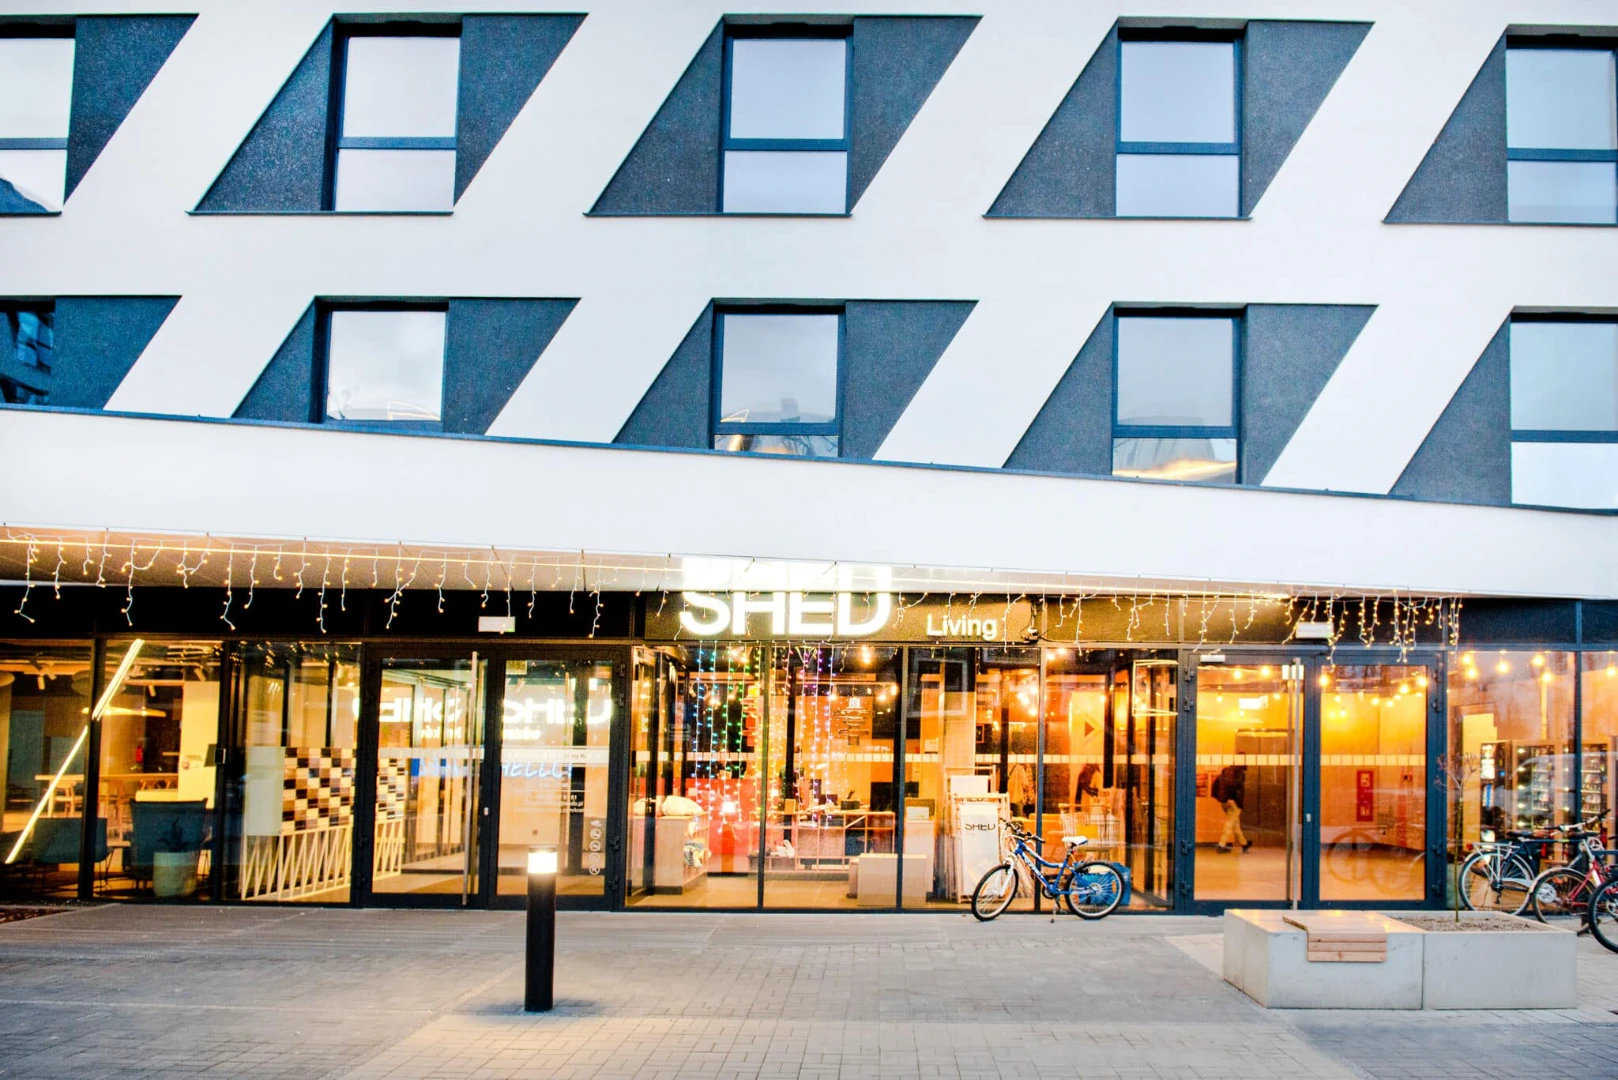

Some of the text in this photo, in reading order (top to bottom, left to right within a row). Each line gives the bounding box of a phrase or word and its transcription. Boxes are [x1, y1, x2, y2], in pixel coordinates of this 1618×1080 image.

[679, 591, 892, 636] SHED
[927, 613, 997, 641] Living
[965, 823, 996, 831] SHED
